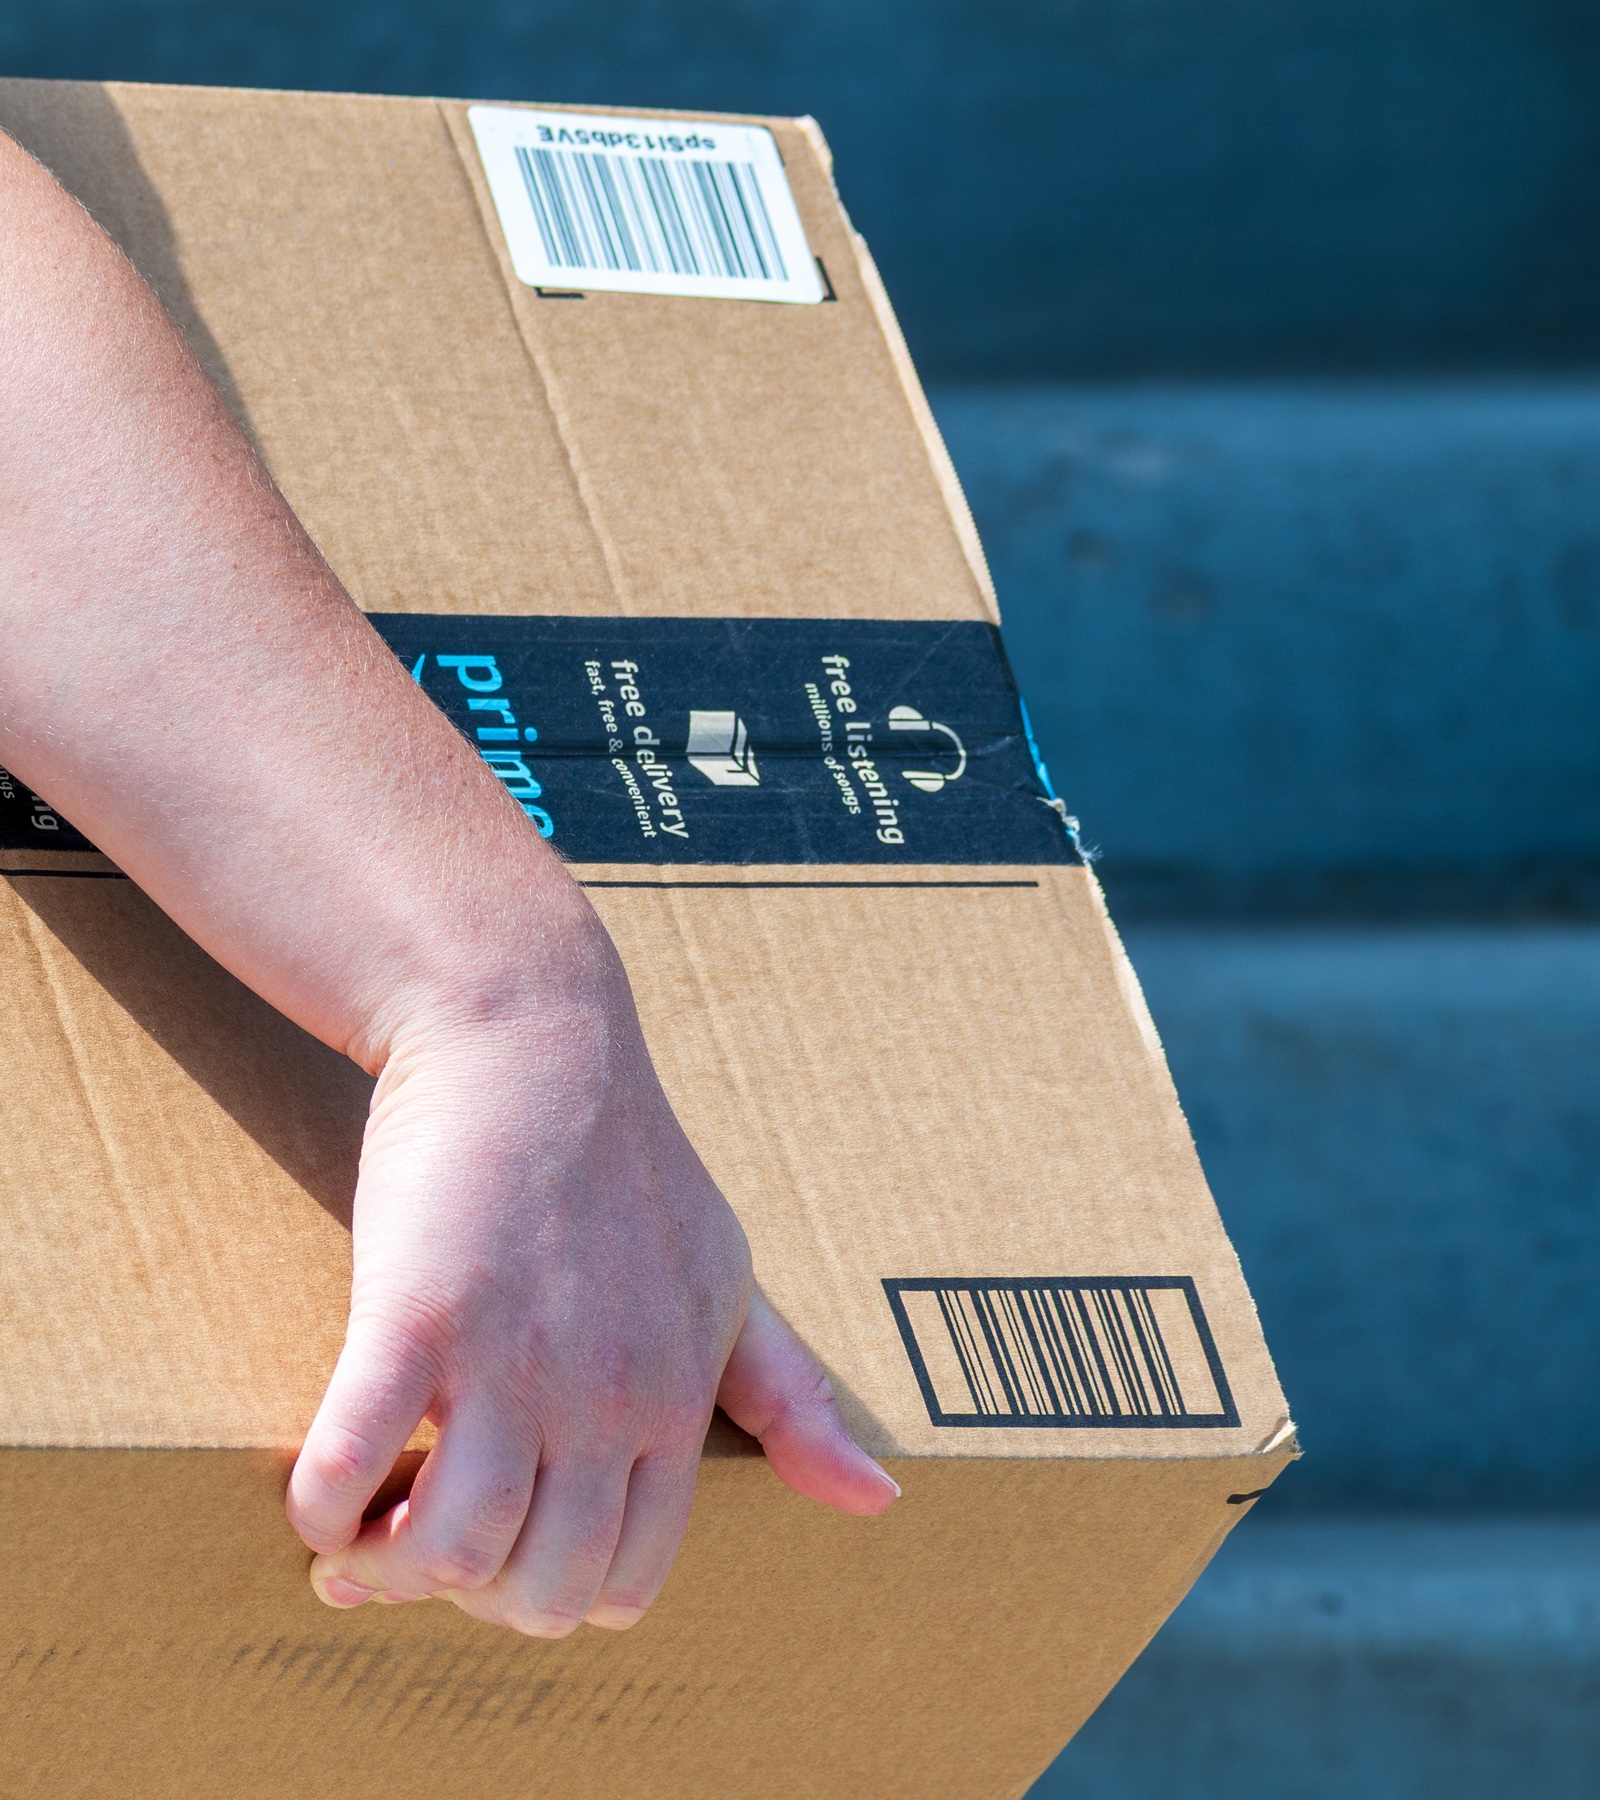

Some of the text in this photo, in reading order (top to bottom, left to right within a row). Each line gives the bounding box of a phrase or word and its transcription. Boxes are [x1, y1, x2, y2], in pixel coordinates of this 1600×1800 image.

[585, 660, 657, 839] fast, free & convenient
[611, 660, 689, 839] free delivery
[805, 682, 861, 815] millions of songs
[821, 654, 905, 844] free listening
